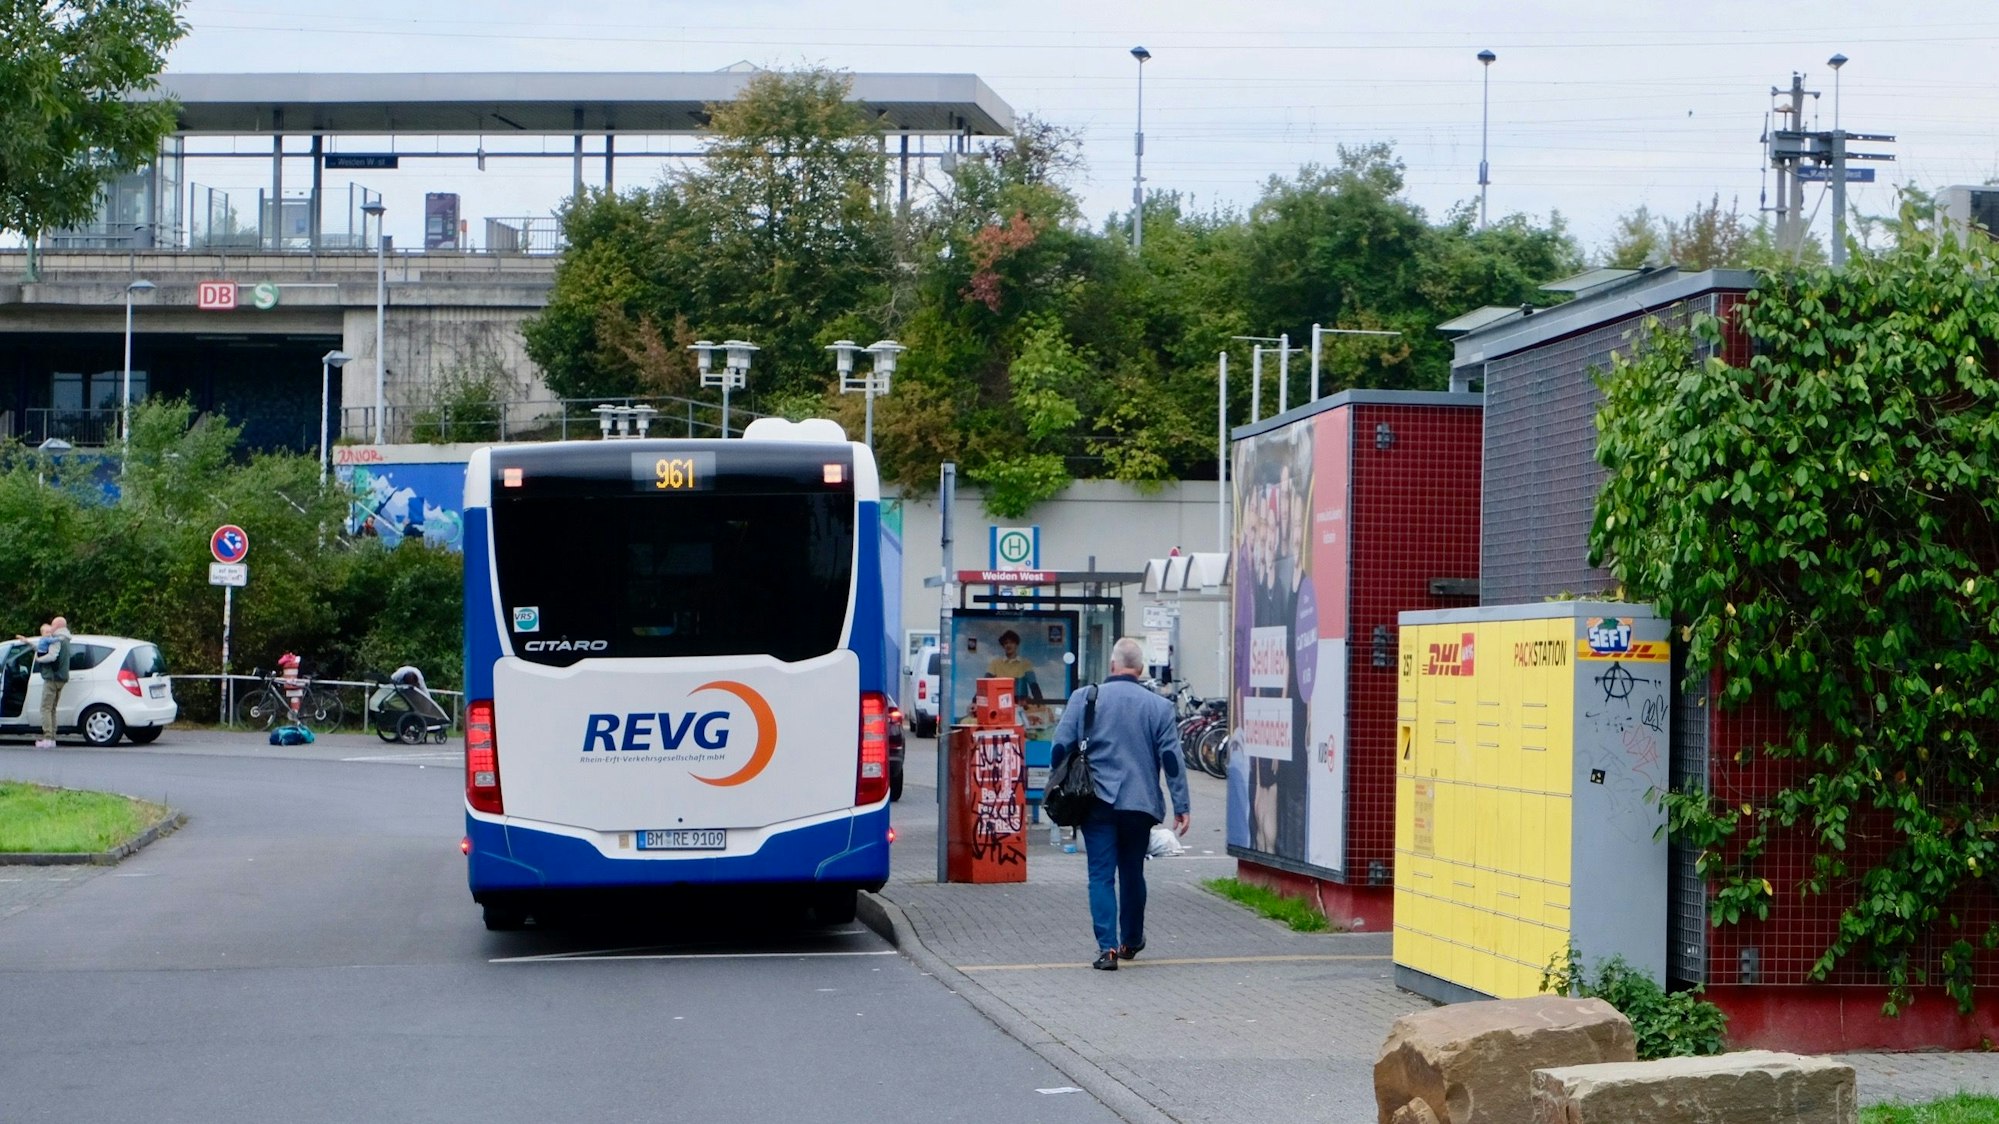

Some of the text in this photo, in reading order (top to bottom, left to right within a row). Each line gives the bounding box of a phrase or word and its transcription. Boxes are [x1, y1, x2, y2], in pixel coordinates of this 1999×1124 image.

[203, 286, 231, 304] DB
[255, 283, 275, 309] S
[656, 459, 693, 489] 961
[982, 571, 1044, 581] Weiden West
[514, 612, 533, 620] VRS
[524, 640, 608, 652] CITARO
[1588, 626, 1631, 649] SEFT
[1428, 643, 1461, 676] DHL
[1513, 639, 1567, 668] PACKSTATION
[1403, 654, 1413, 676] 257
[582, 711, 730, 752] REVG
[580, 753, 726, 764] Rhein-Erft-Verkehrsgesellschaft mbH
[647, 831, 724, 846] BM RE 9109
